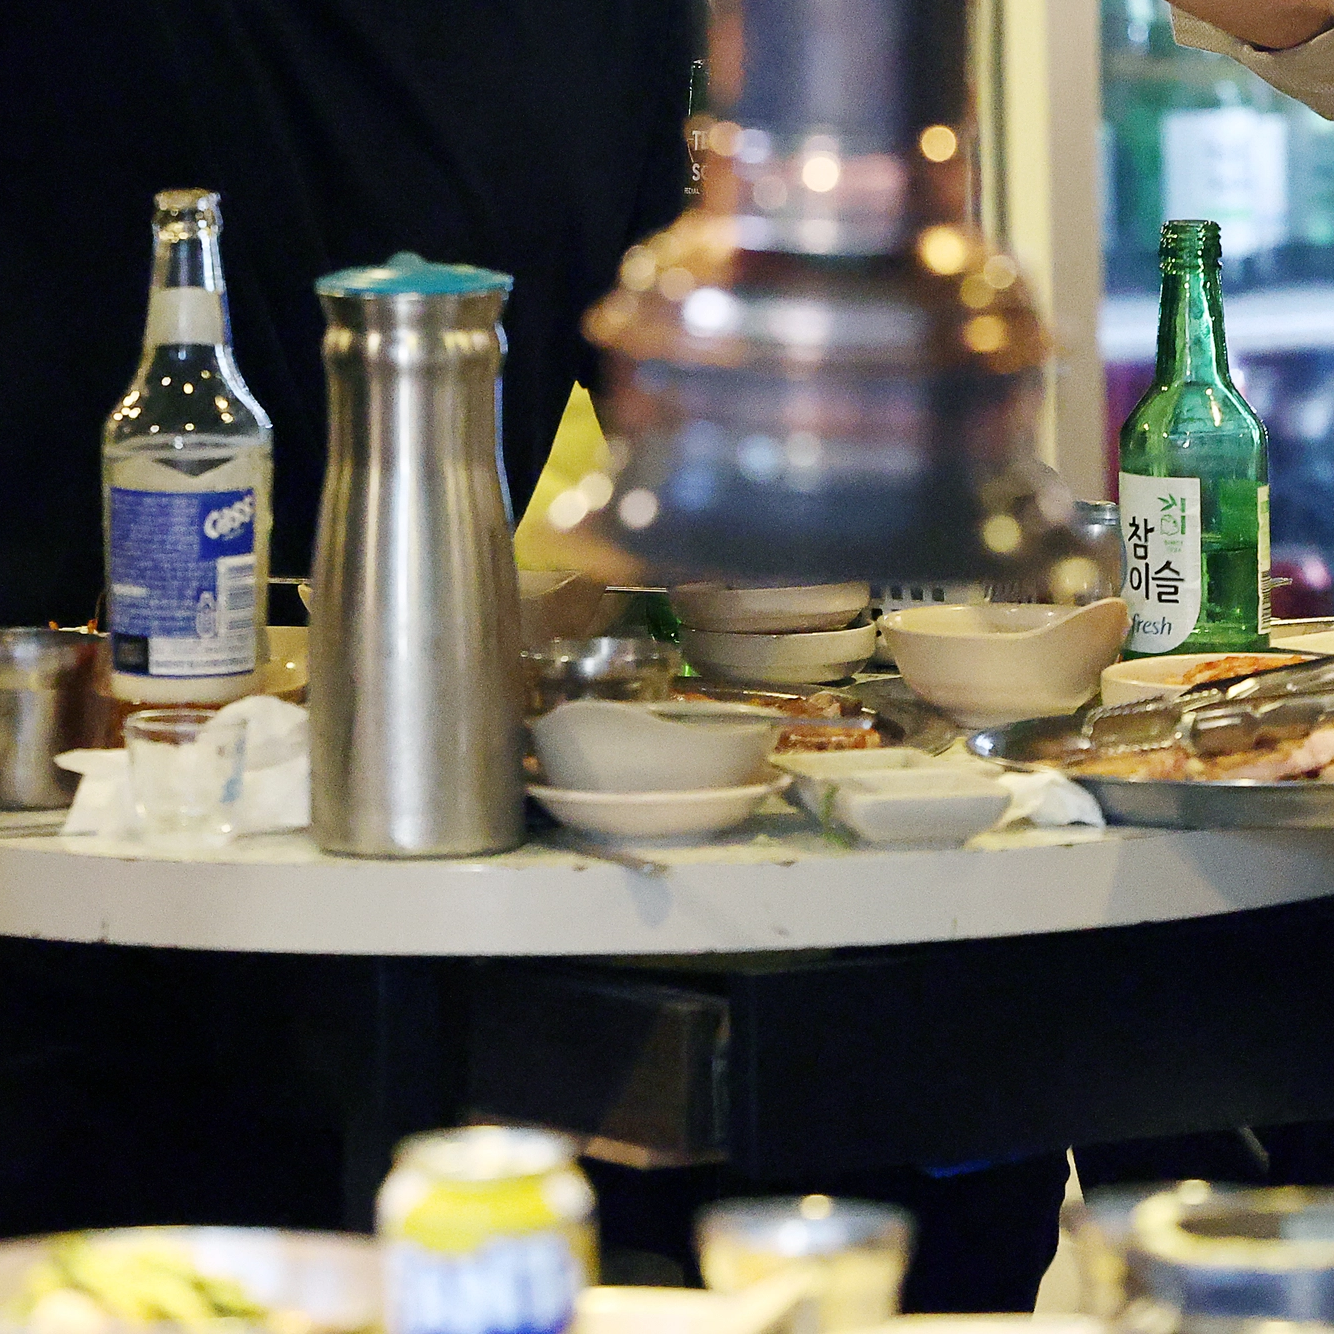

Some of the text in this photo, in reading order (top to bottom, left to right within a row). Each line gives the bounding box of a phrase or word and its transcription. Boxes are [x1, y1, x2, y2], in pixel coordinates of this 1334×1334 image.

[1128, 516, 1155, 560] 참
[1129, 560, 1185, 604] 이슬
[1132, 613, 1172, 636] fresh
